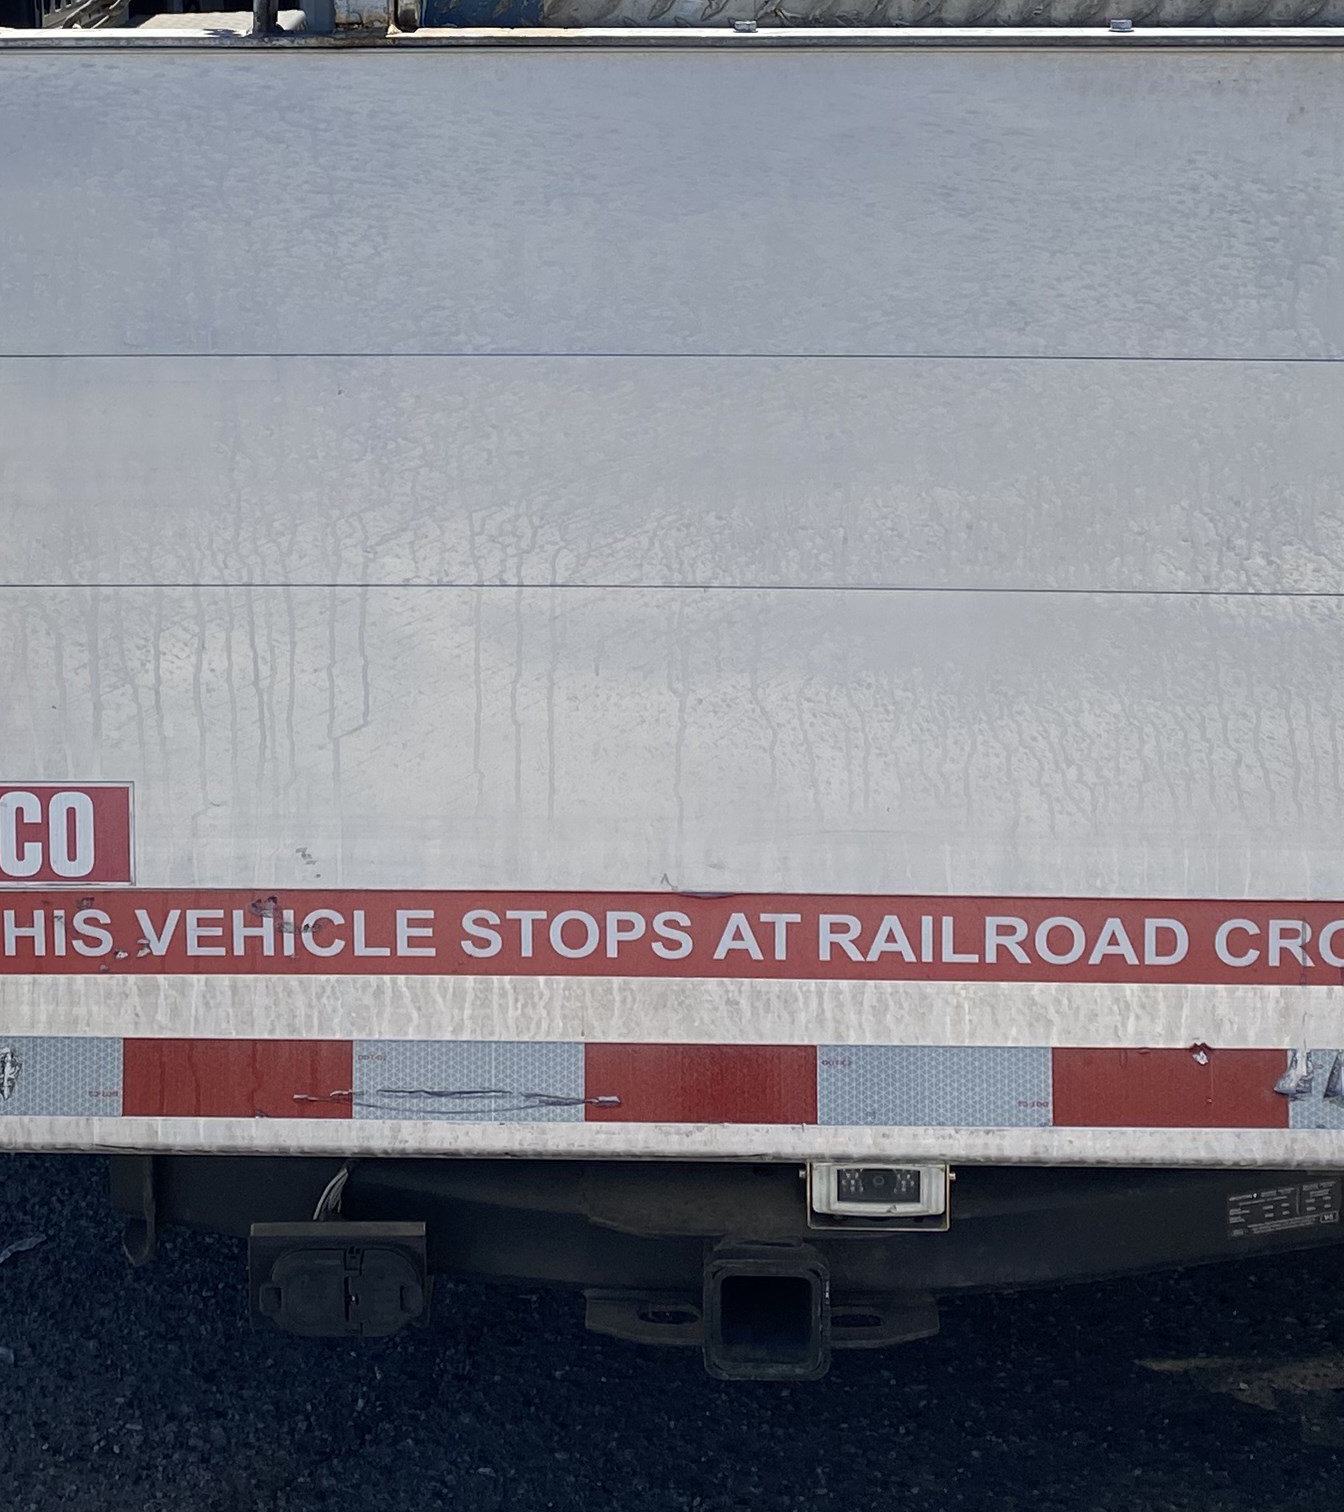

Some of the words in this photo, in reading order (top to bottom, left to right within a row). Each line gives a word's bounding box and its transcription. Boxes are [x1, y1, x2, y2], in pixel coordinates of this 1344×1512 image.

[134, 908, 437, 958] VEHICLE
[460, 909, 694, 960] STOPS
[713, 912, 802, 961] AT
[819, 913, 1190, 966] RAILROAD
